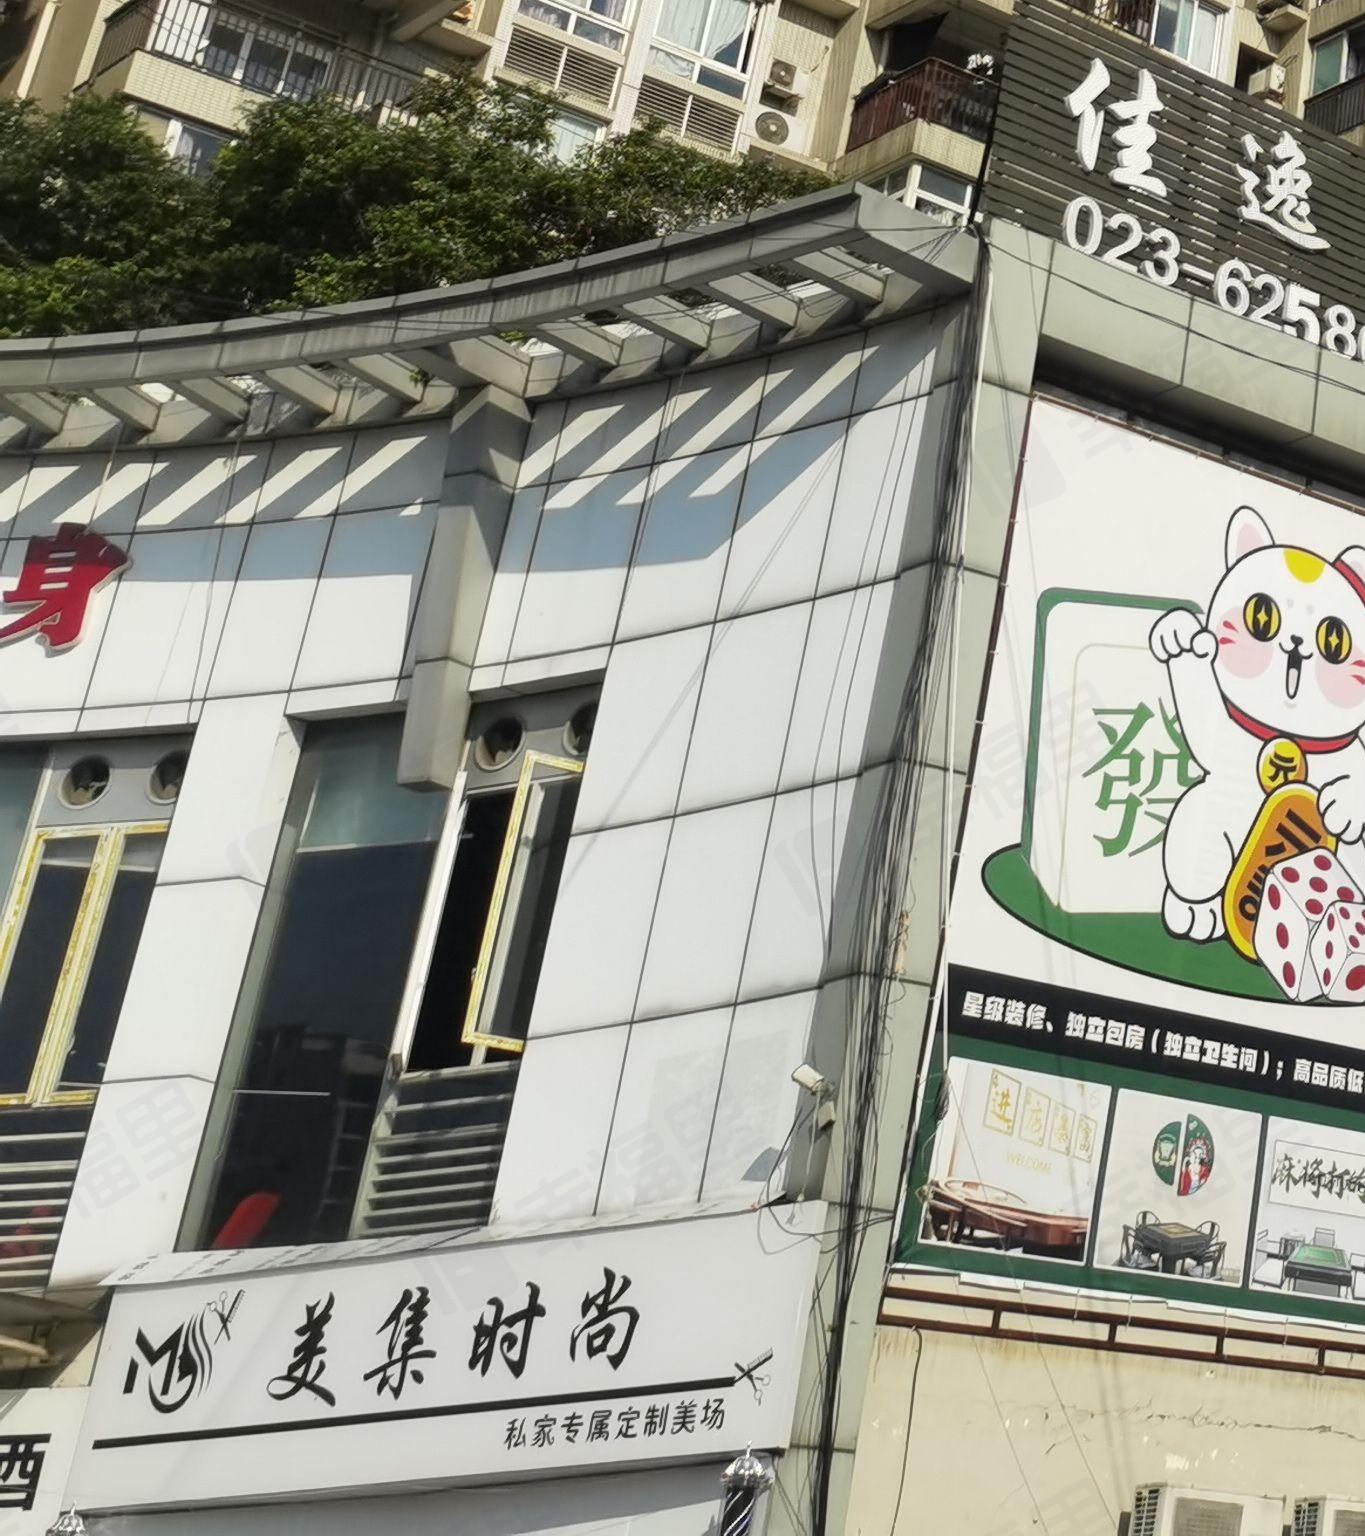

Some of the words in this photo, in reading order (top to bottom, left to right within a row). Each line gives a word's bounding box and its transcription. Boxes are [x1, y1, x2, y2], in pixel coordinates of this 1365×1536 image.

[0, 521, 133, 658] 身
[266, 1267, 642, 1409] 美集时尚
[503, 1397, 726, 1451] 私家专属定制美场
